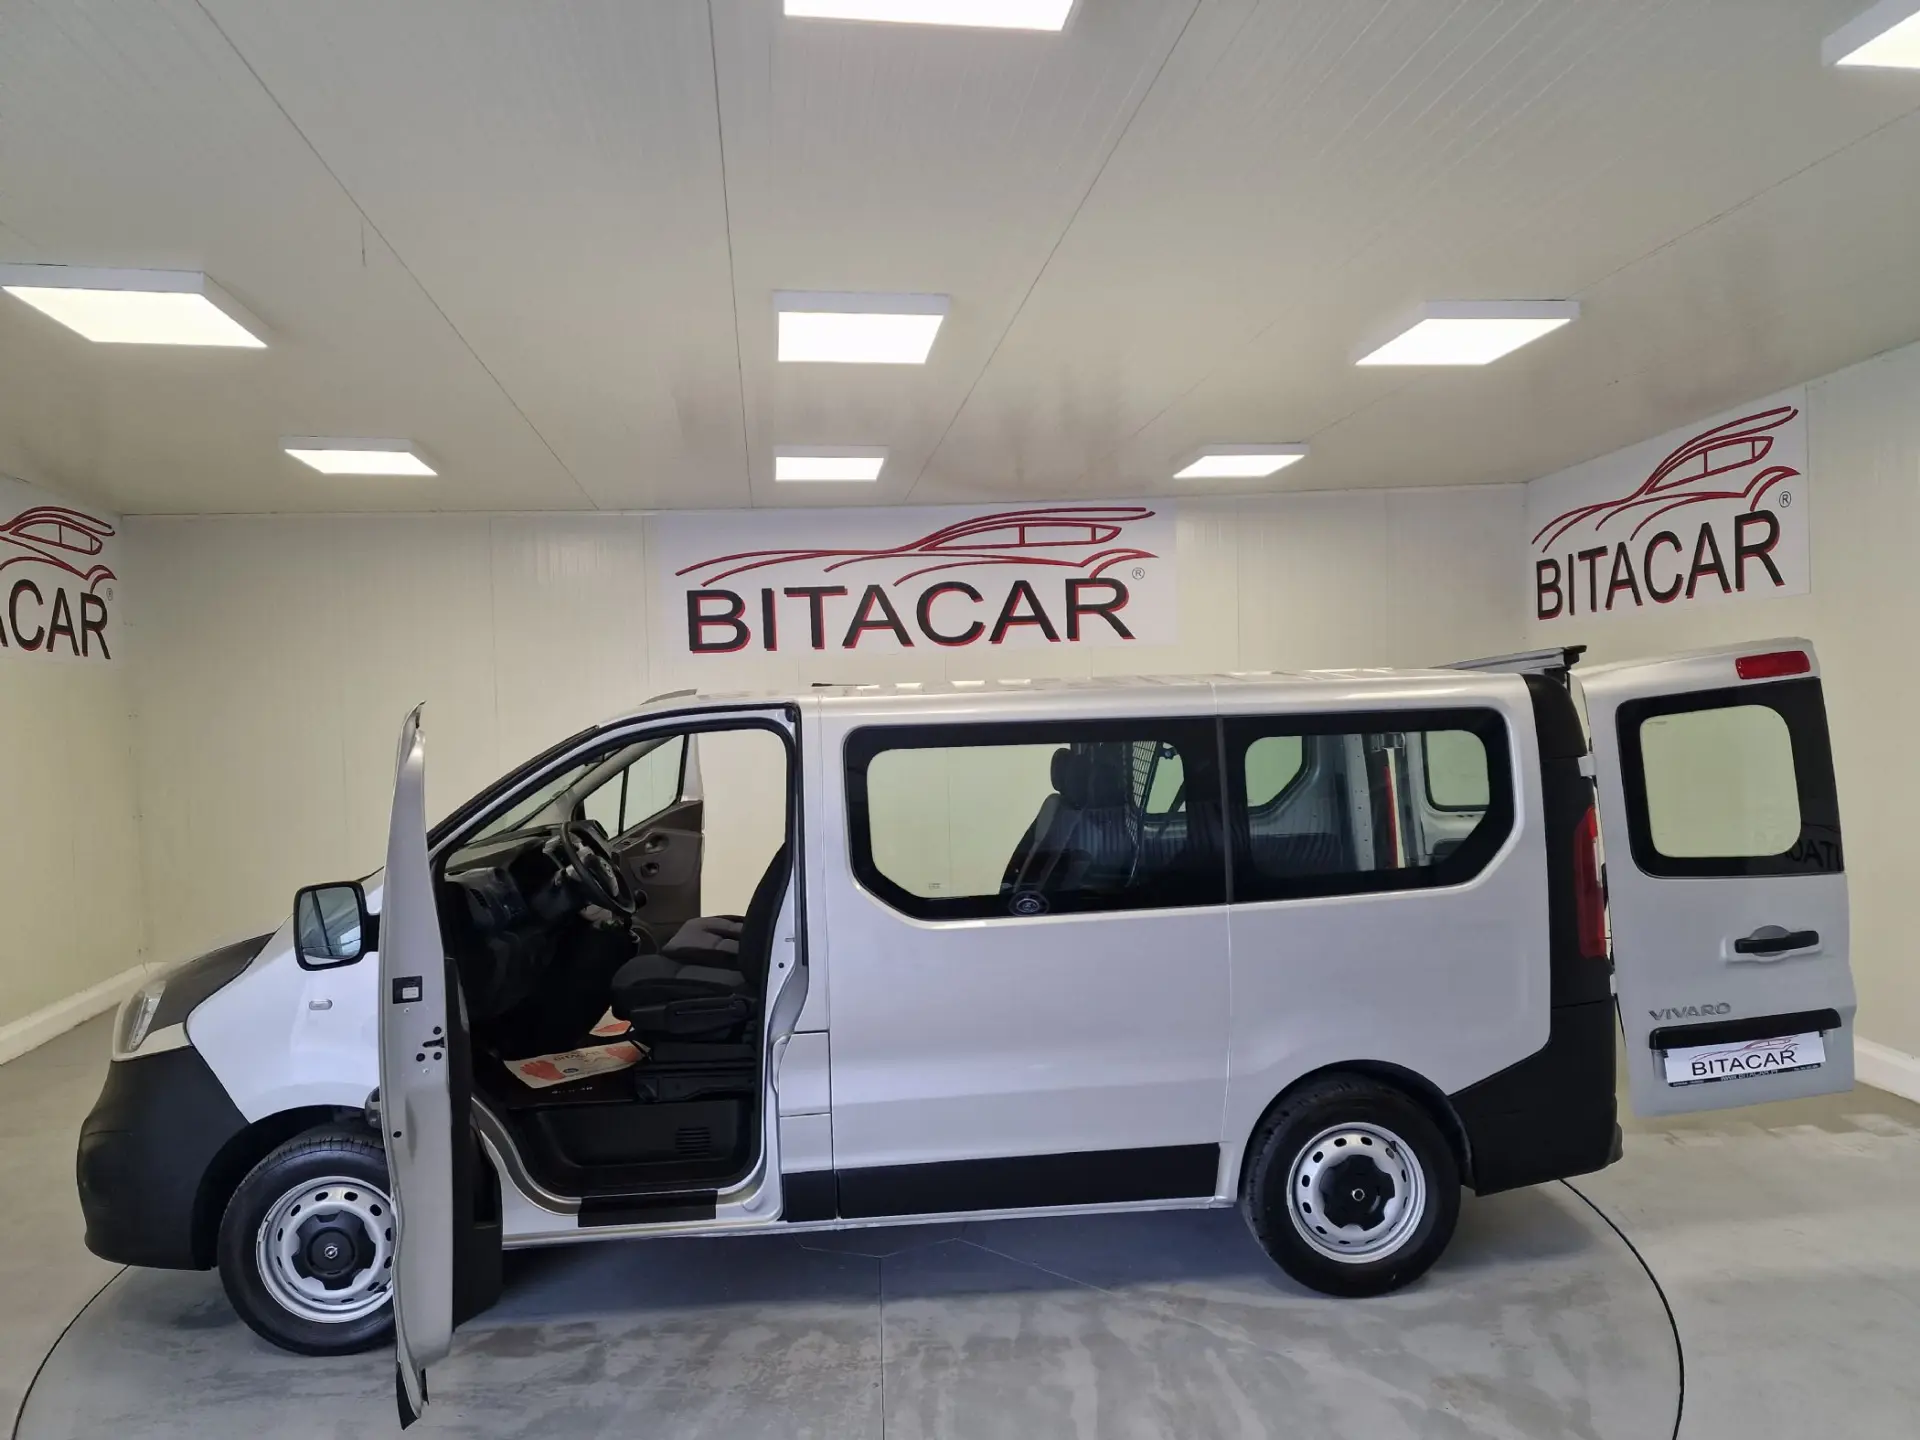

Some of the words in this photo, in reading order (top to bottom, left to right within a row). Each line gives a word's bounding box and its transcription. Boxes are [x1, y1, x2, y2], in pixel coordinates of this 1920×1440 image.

[1536, 510, 1786, 620] BITACAR
[686, 578, 1136, 654] BITACAR
[1648, 1002, 1731, 1021] VIVARO
[1691, 1050, 1797, 1077] BITACAR
